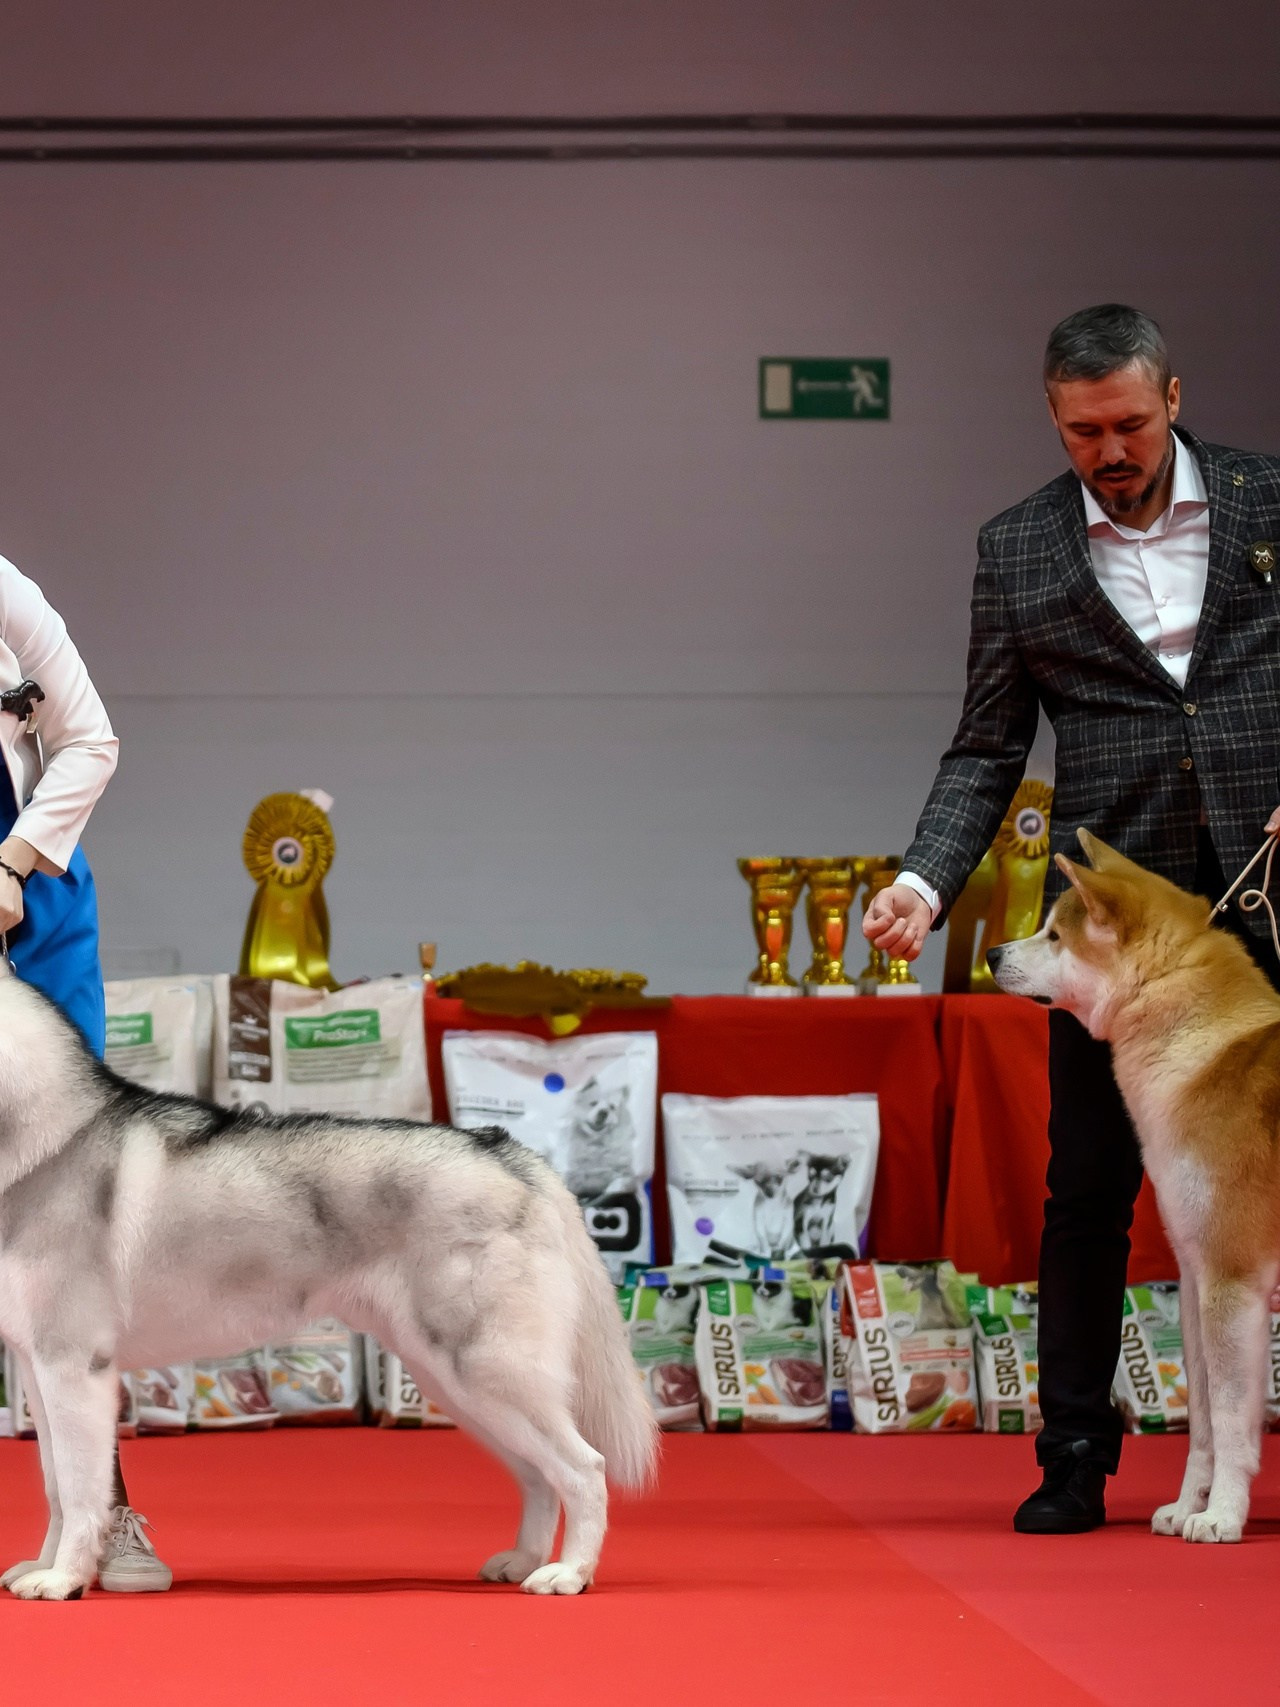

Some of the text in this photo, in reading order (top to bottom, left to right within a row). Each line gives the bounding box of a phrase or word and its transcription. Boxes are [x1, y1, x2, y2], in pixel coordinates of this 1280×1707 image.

[711, 1322, 741, 1396] SIRIUS
[865, 1327, 901, 1422] SIRIUS
[992, 1336, 1022, 1396] SIRIUS
[1121, 1322, 1160, 1404] SIRIUS
